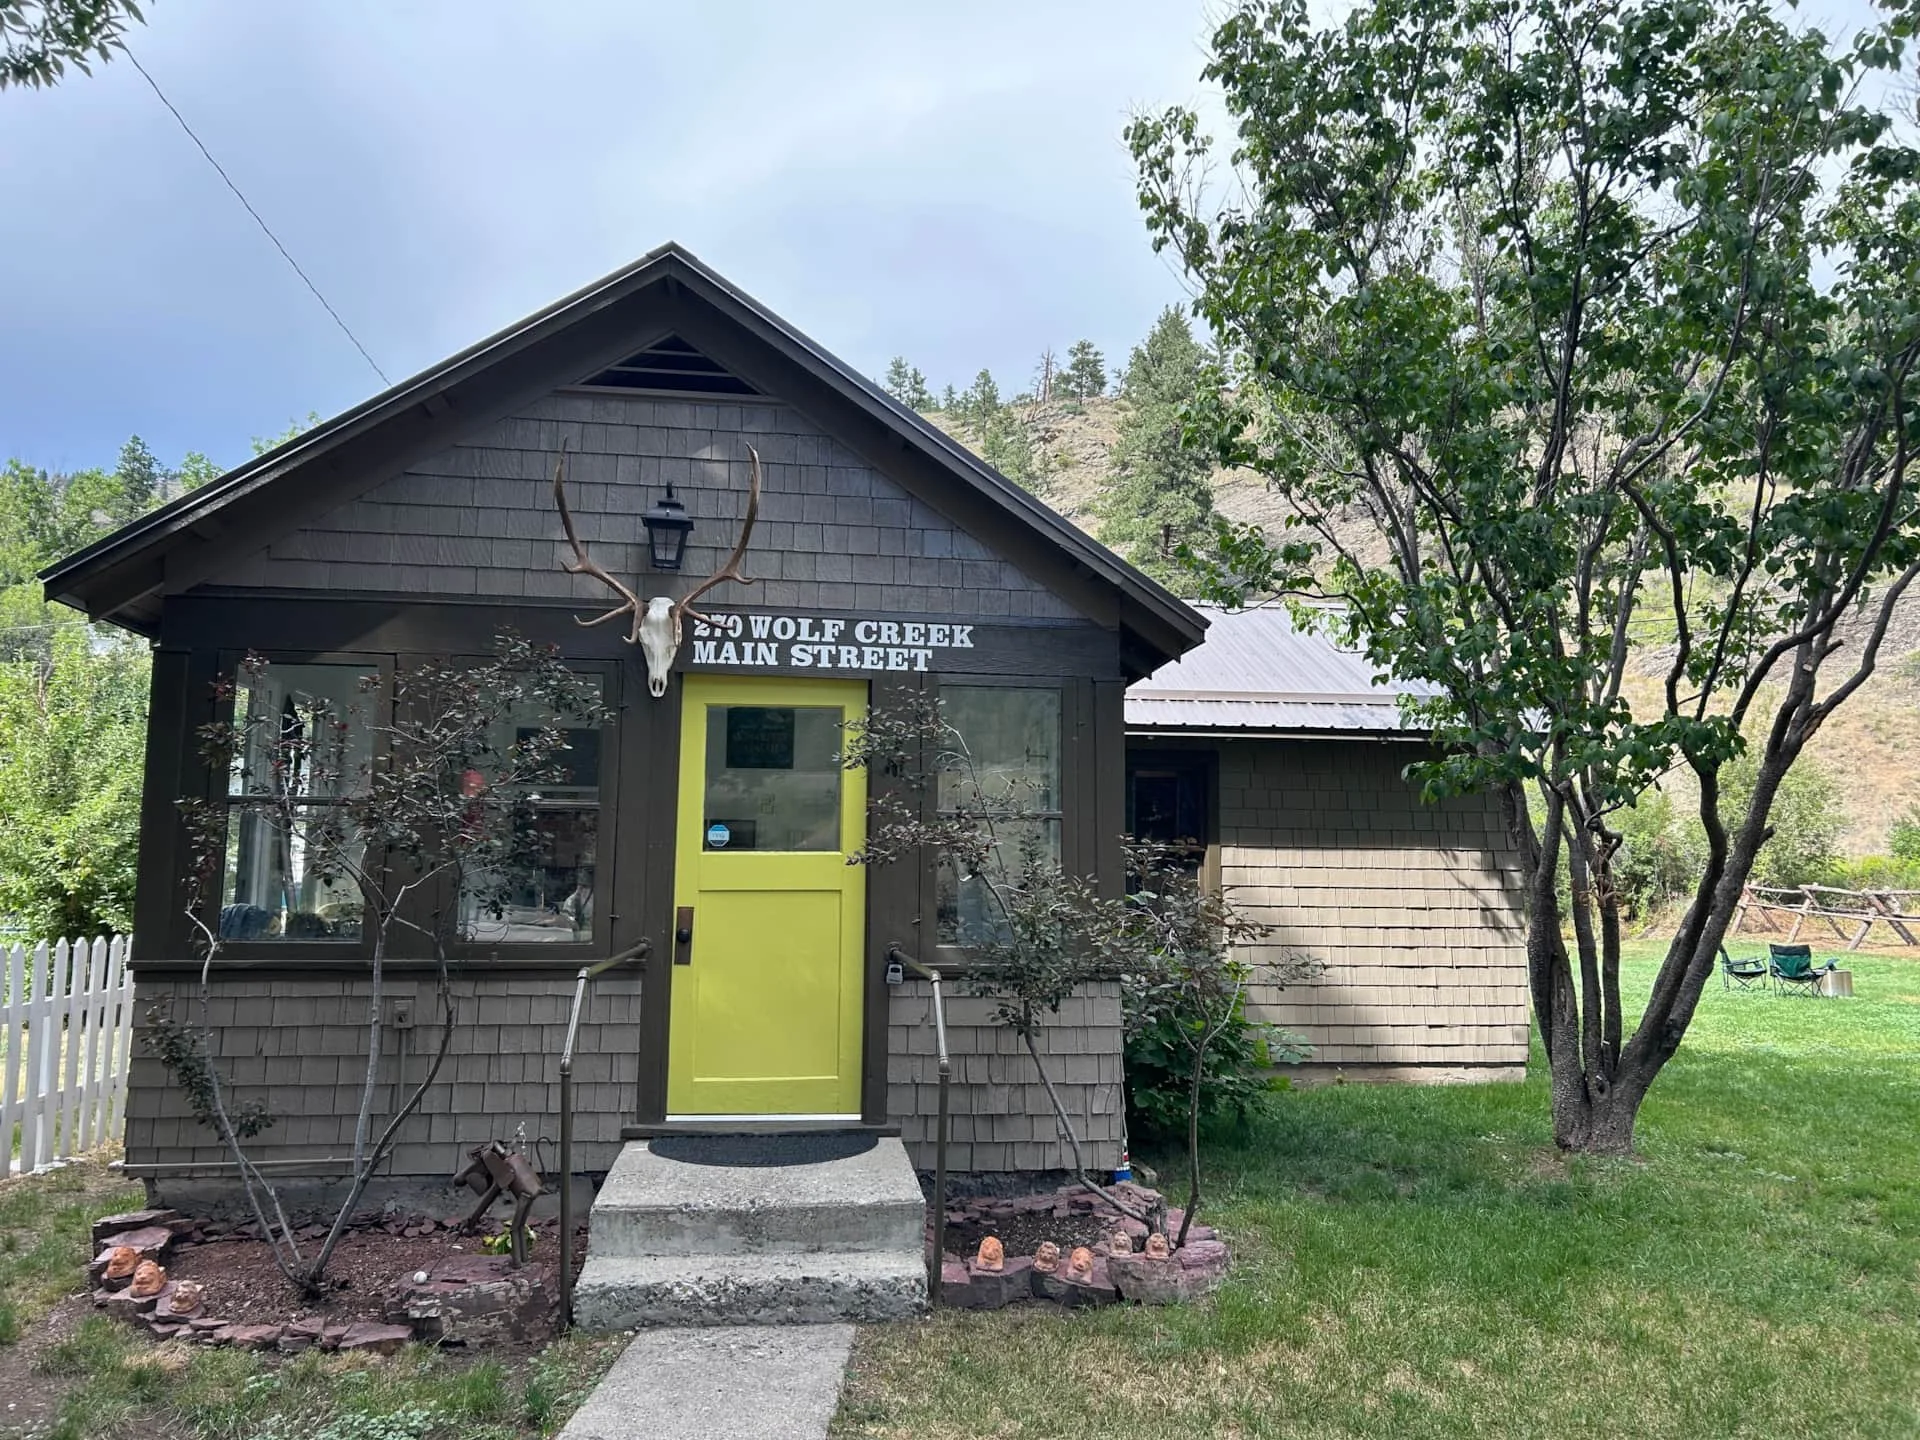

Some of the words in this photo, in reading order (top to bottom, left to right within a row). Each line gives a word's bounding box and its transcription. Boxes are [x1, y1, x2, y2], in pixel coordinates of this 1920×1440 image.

[749, 616, 845, 642] WOLF
[854, 620, 974, 648] CREEK
[693, 640, 778, 665] MAIN
[791, 644, 933, 672] STREET
